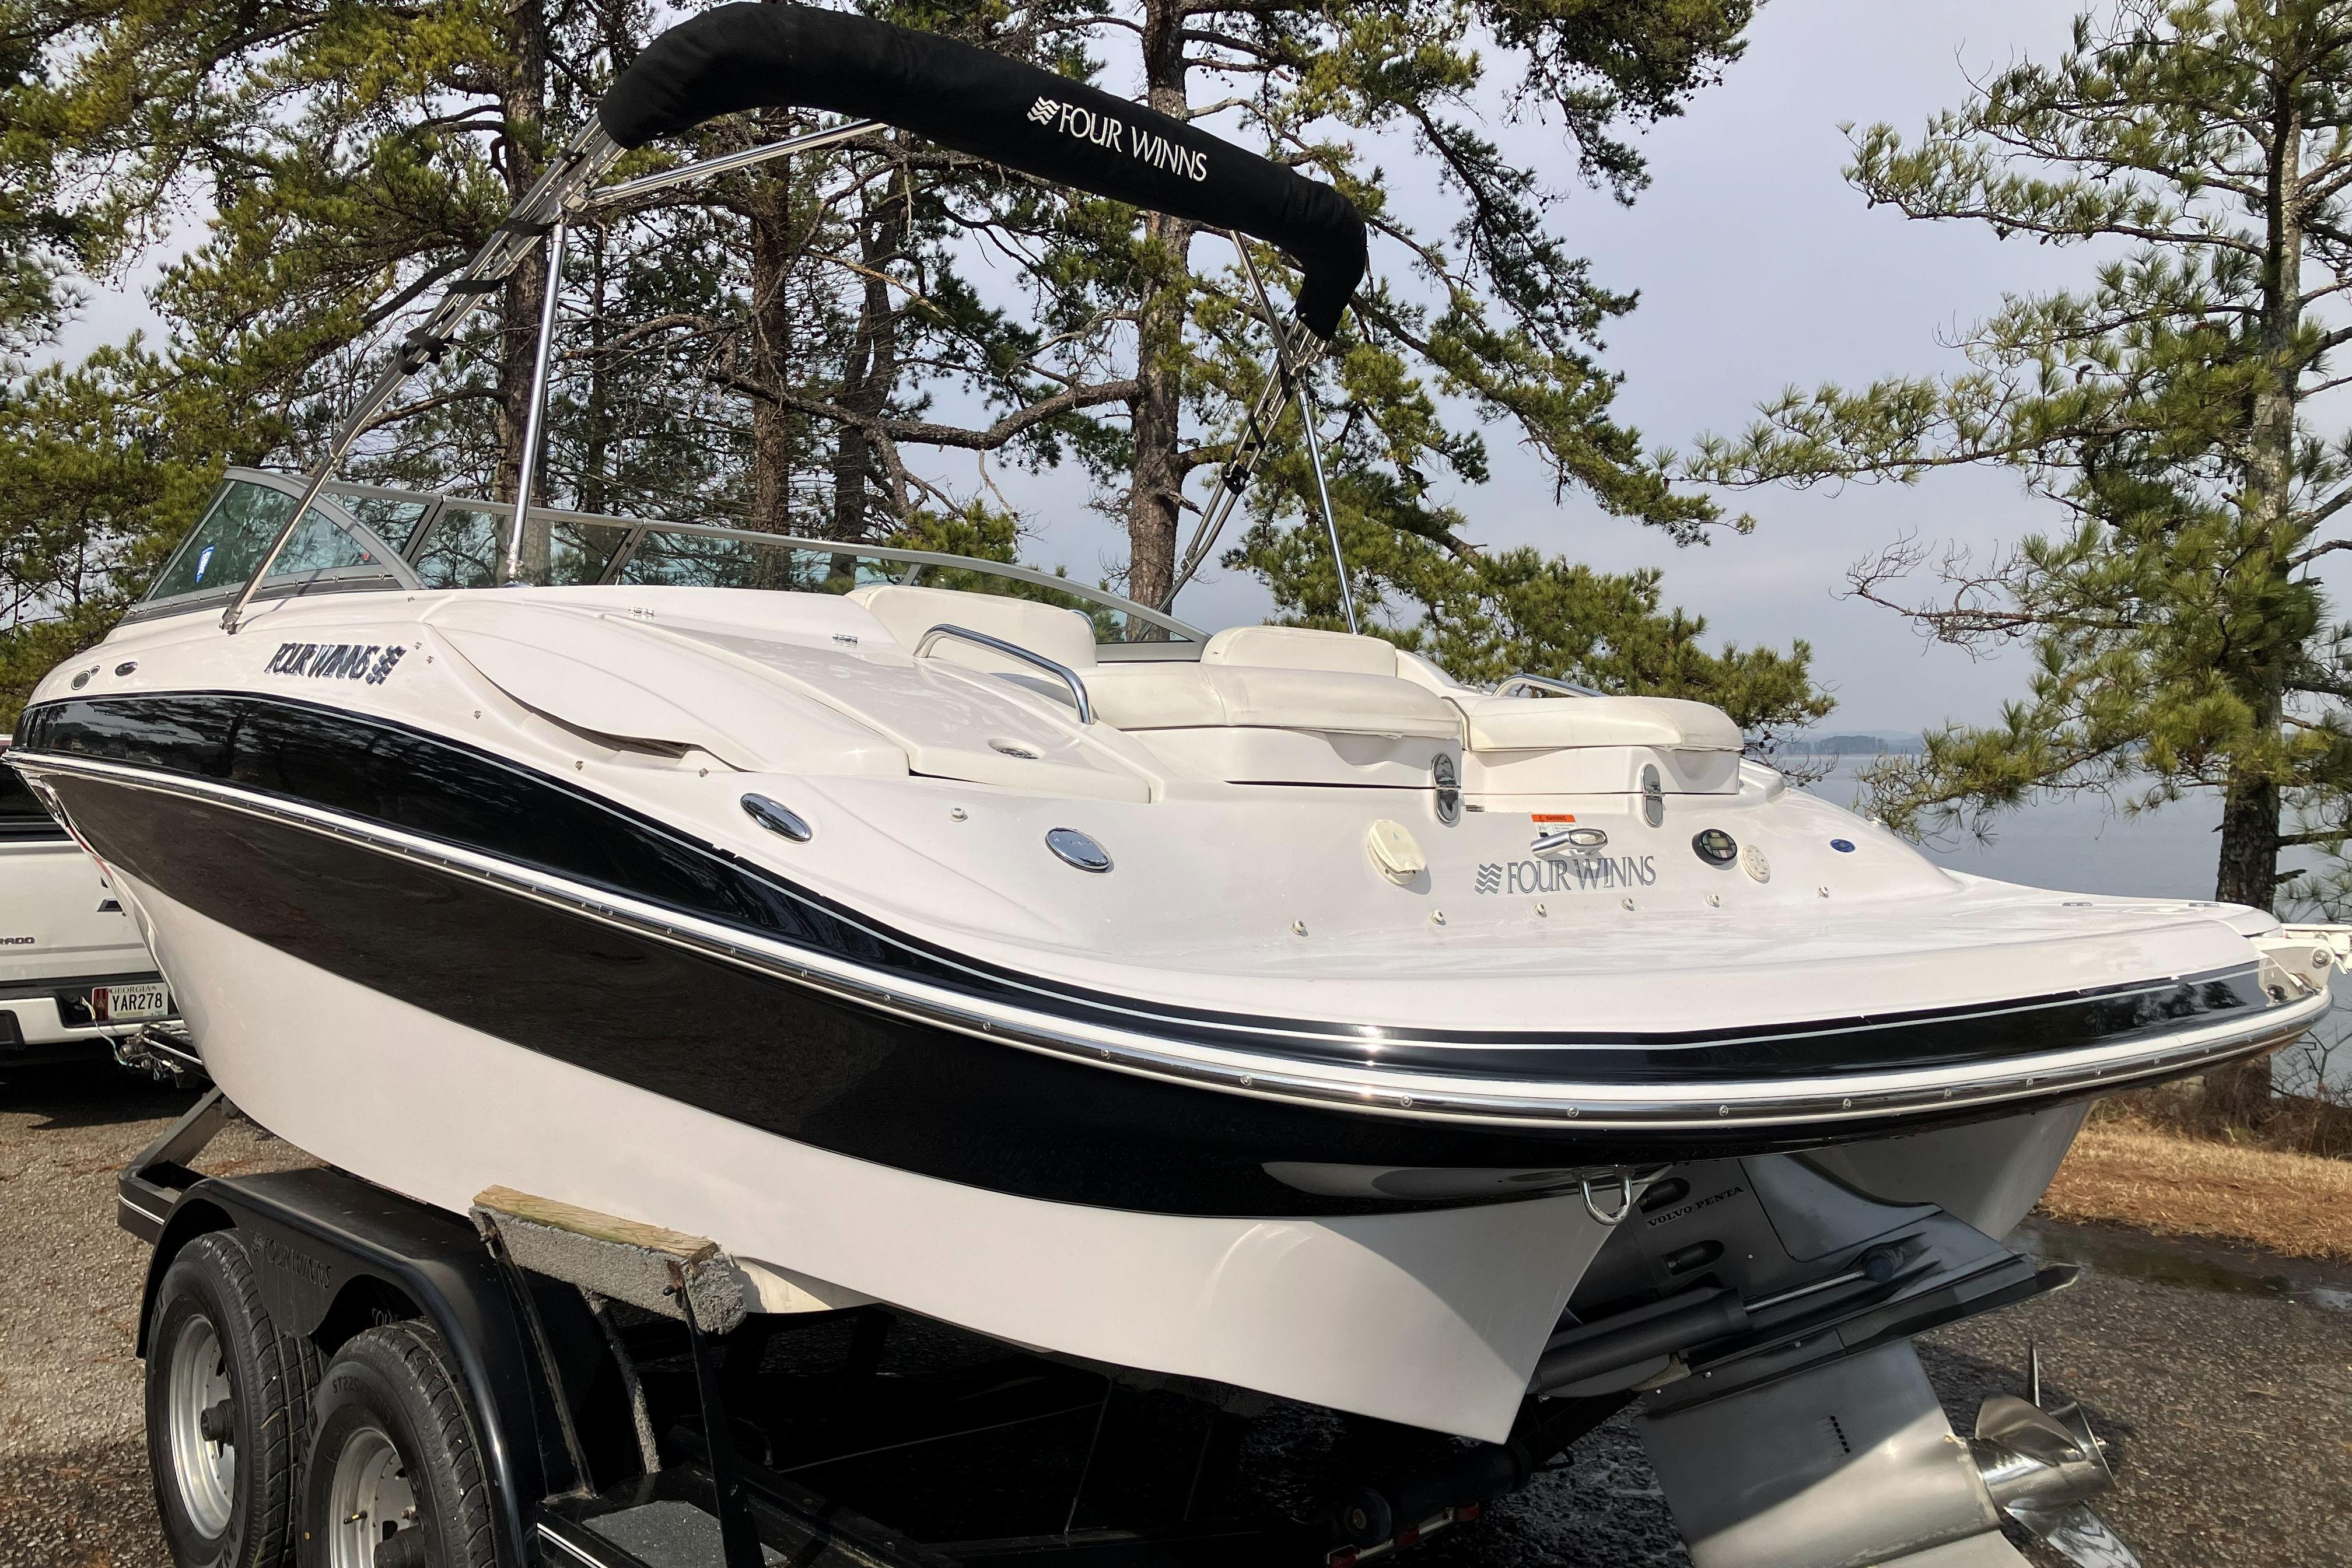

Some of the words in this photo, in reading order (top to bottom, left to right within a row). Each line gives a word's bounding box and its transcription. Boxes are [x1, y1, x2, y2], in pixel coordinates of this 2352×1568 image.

[1059, 103, 1122, 153] FOUR
[1130, 125, 1207, 182] WINNS
[264, 642, 319, 677] FOUR
[1507, 860, 1572, 894] FOUR
[1573, 855, 1657, 891] WINNS
[110, 985, 151, 994] GEORGIA
[112, 992, 163, 1012] YAR278
[1647, 1205, 1693, 1227] VOLVO
[1695, 1186, 1745, 1210] PENTA
